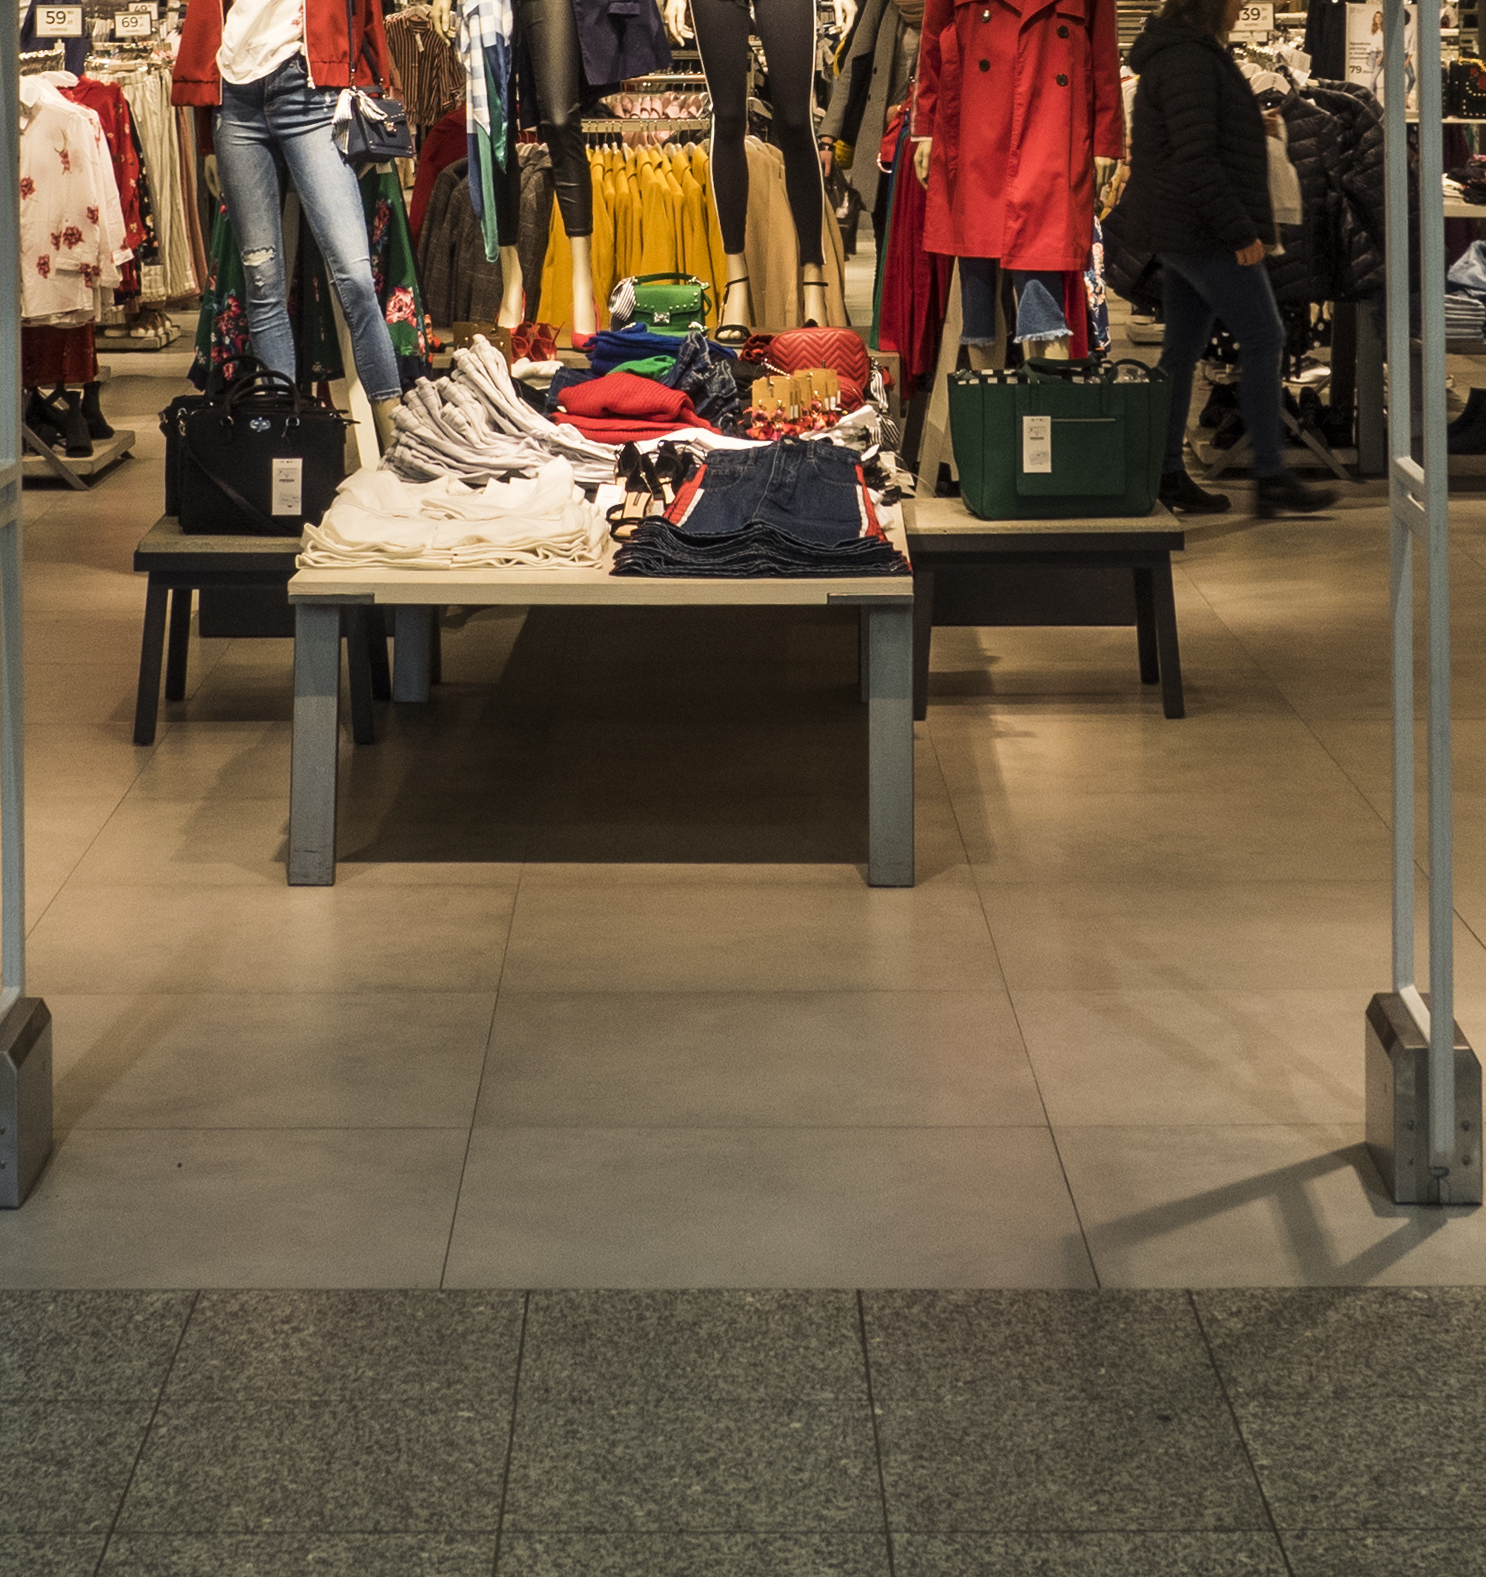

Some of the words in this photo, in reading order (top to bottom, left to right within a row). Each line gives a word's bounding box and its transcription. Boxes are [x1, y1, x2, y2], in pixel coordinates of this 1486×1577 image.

[45, 10, 66, 25] 59
[121, 16, 139, 28] 69
[1349, 65, 1362, 74] 79
